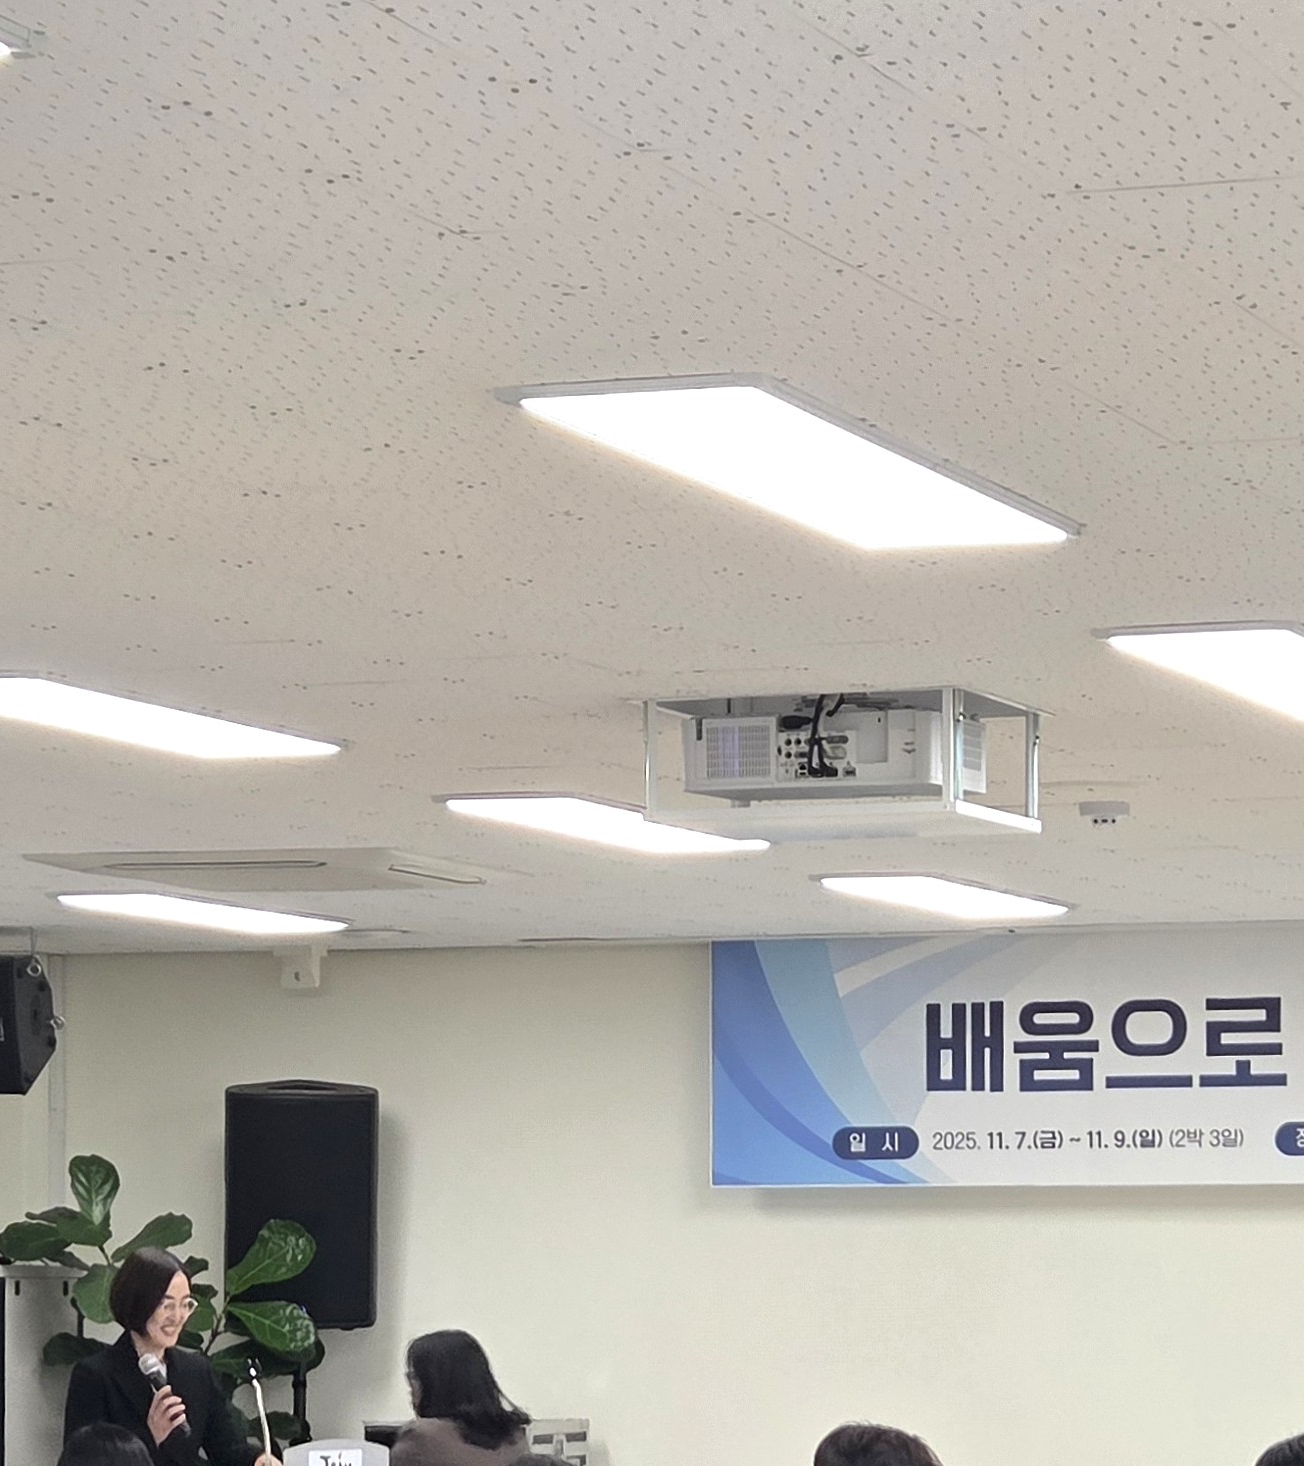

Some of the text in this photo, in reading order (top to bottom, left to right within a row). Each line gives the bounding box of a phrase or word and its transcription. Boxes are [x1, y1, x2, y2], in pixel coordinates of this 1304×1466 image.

[925, 996, 1288, 1093] 배움으로
[932, 1131, 981, 1151] 2025.
[1168, 1127, 1204, 1149] (2박
[1208, 1127, 1244, 1148] 3일)
